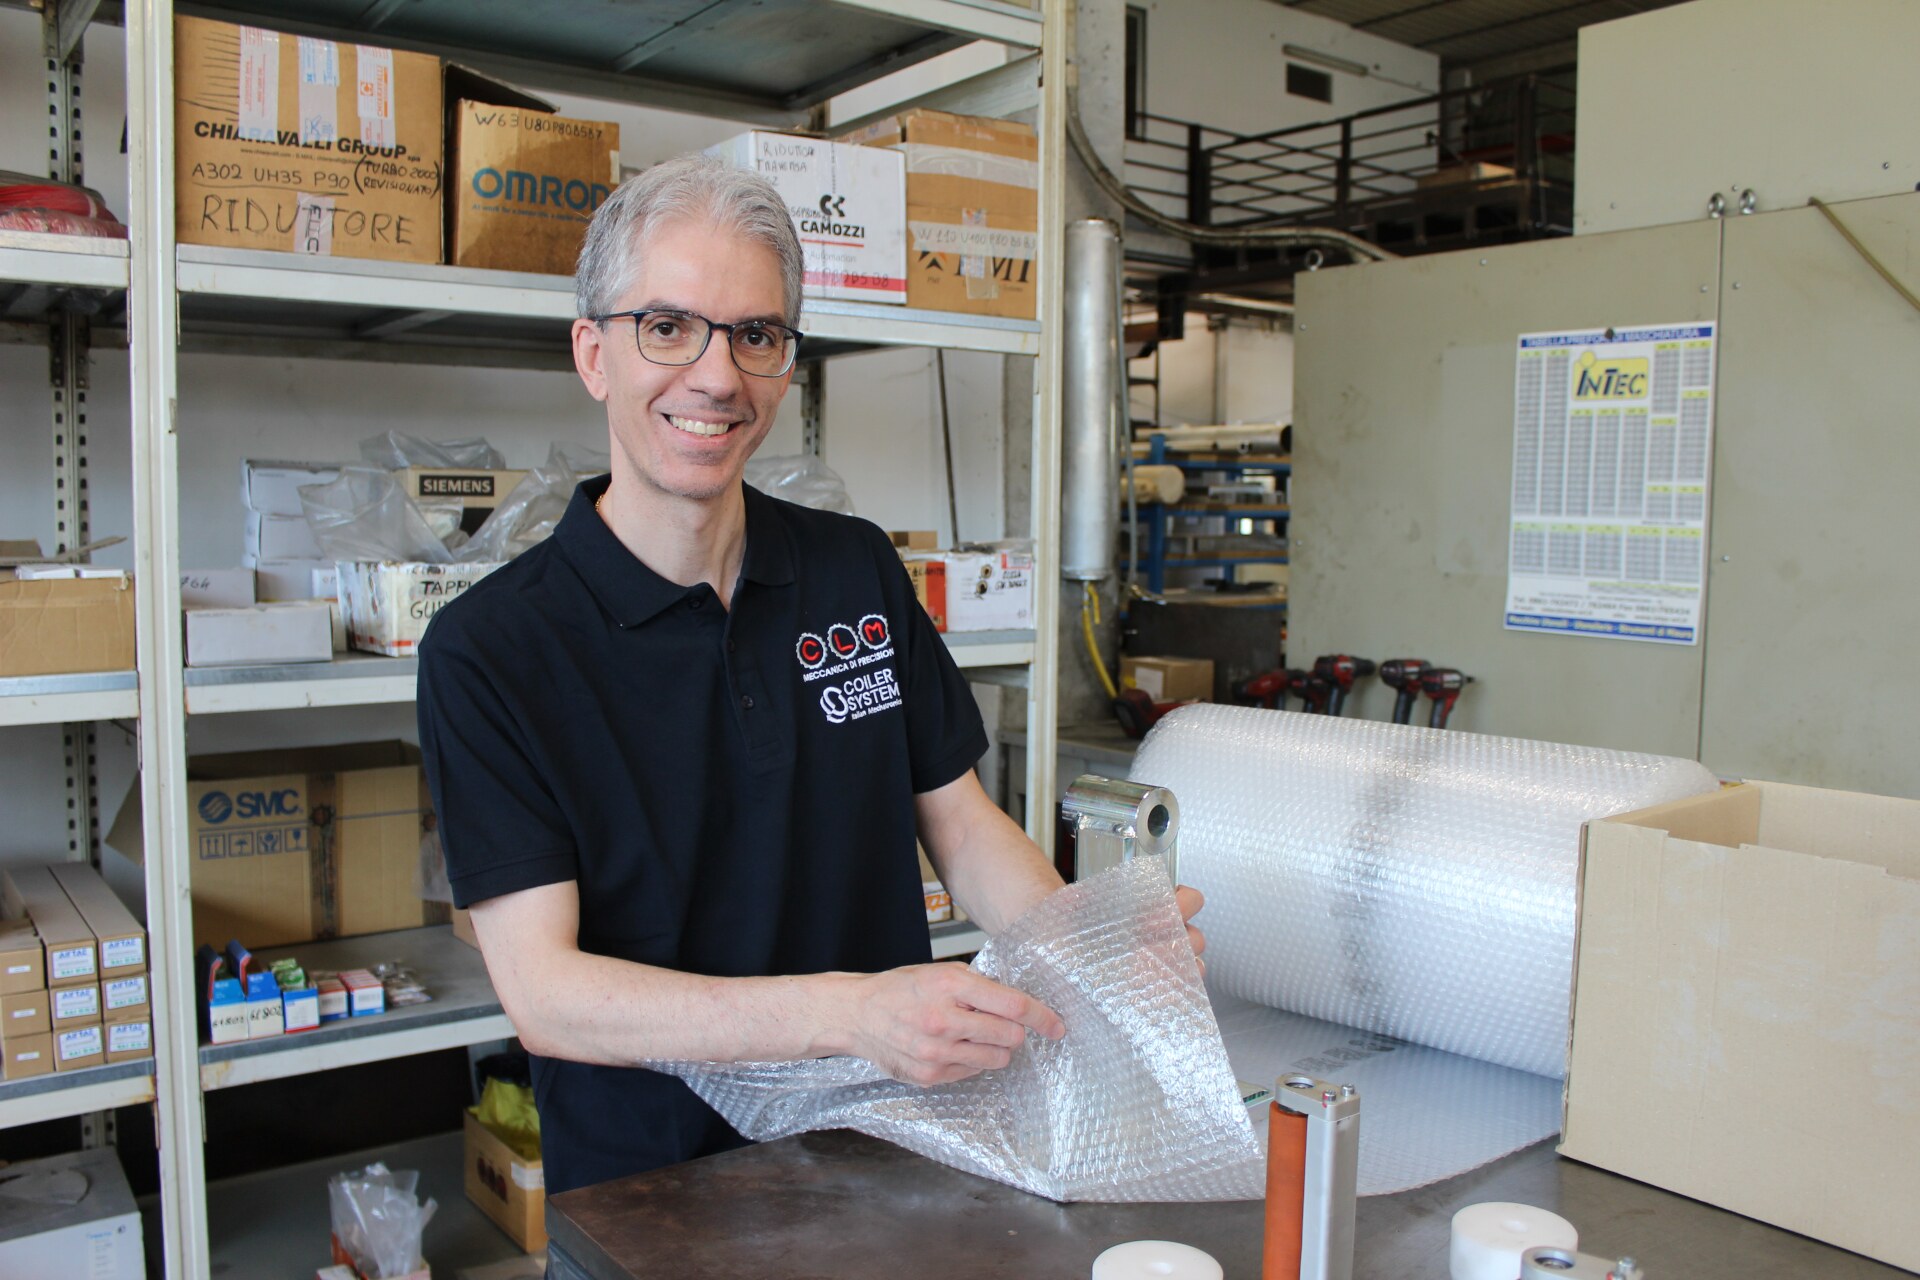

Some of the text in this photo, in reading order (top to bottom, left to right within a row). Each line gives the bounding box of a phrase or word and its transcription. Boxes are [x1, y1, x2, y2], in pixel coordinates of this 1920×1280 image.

[337, 137, 407, 159] GROUP
[192, 163, 350, 189] A302 UH35 P90
[201, 194, 413, 244] RIDUTTORE
[800, 220, 865, 238] CAMOZZI
[423, 479, 491, 493] SIEMENS
[803, 664, 849, 682] MECCANICA
[849, 659, 857, 669] DI
[843, 668, 895, 696] COILER
[847, 682, 901, 712] SYSTEM
[236, 789, 299, 818] SMC
